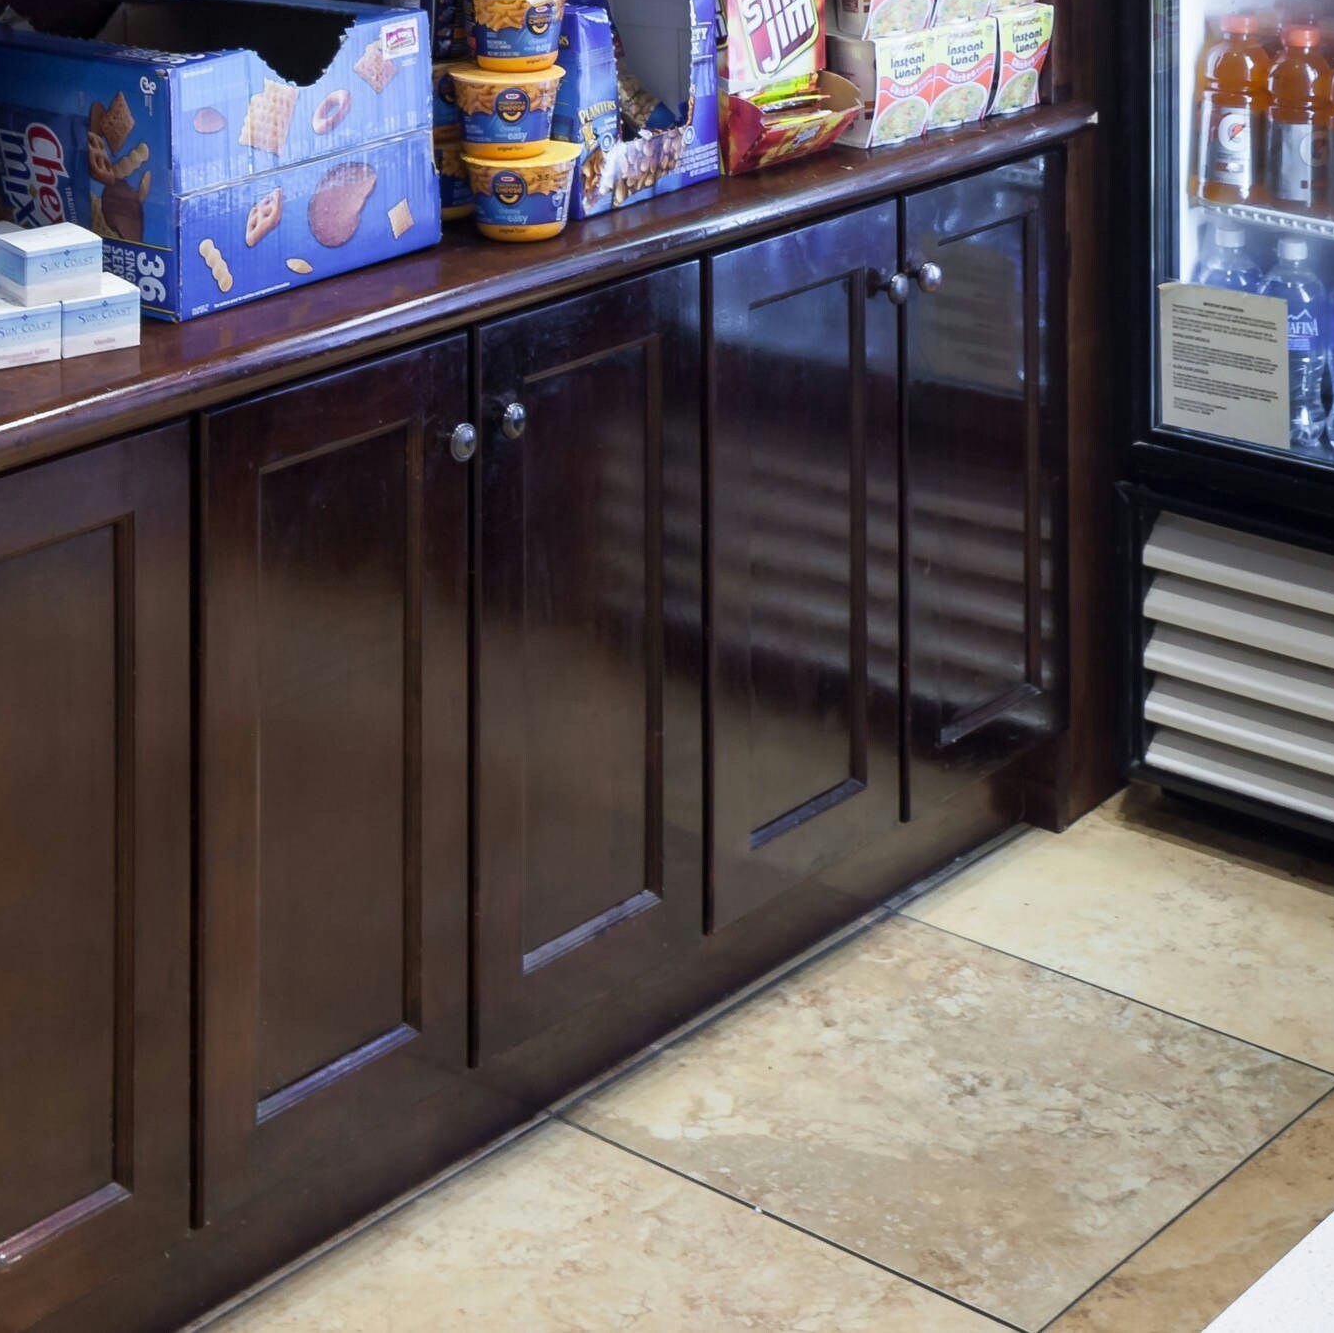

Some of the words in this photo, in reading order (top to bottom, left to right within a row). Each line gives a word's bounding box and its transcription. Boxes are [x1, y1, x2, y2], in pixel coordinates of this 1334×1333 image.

[1012, 28, 1043, 43] Instant
[947, 41, 984, 56] Instant
[1015, 40, 1039, 54] Lunch
[890, 53, 925, 67] Instant
[951, 54, 980, 66] Lunch
[894, 66, 922, 80] Lunch
[578, 100, 617, 125] PLANTERS
[507, 132, 528, 143] easy
[26, 122, 69, 224] Chex
[507, 214, 529, 225] easy
[137, 251, 166, 303] 36
